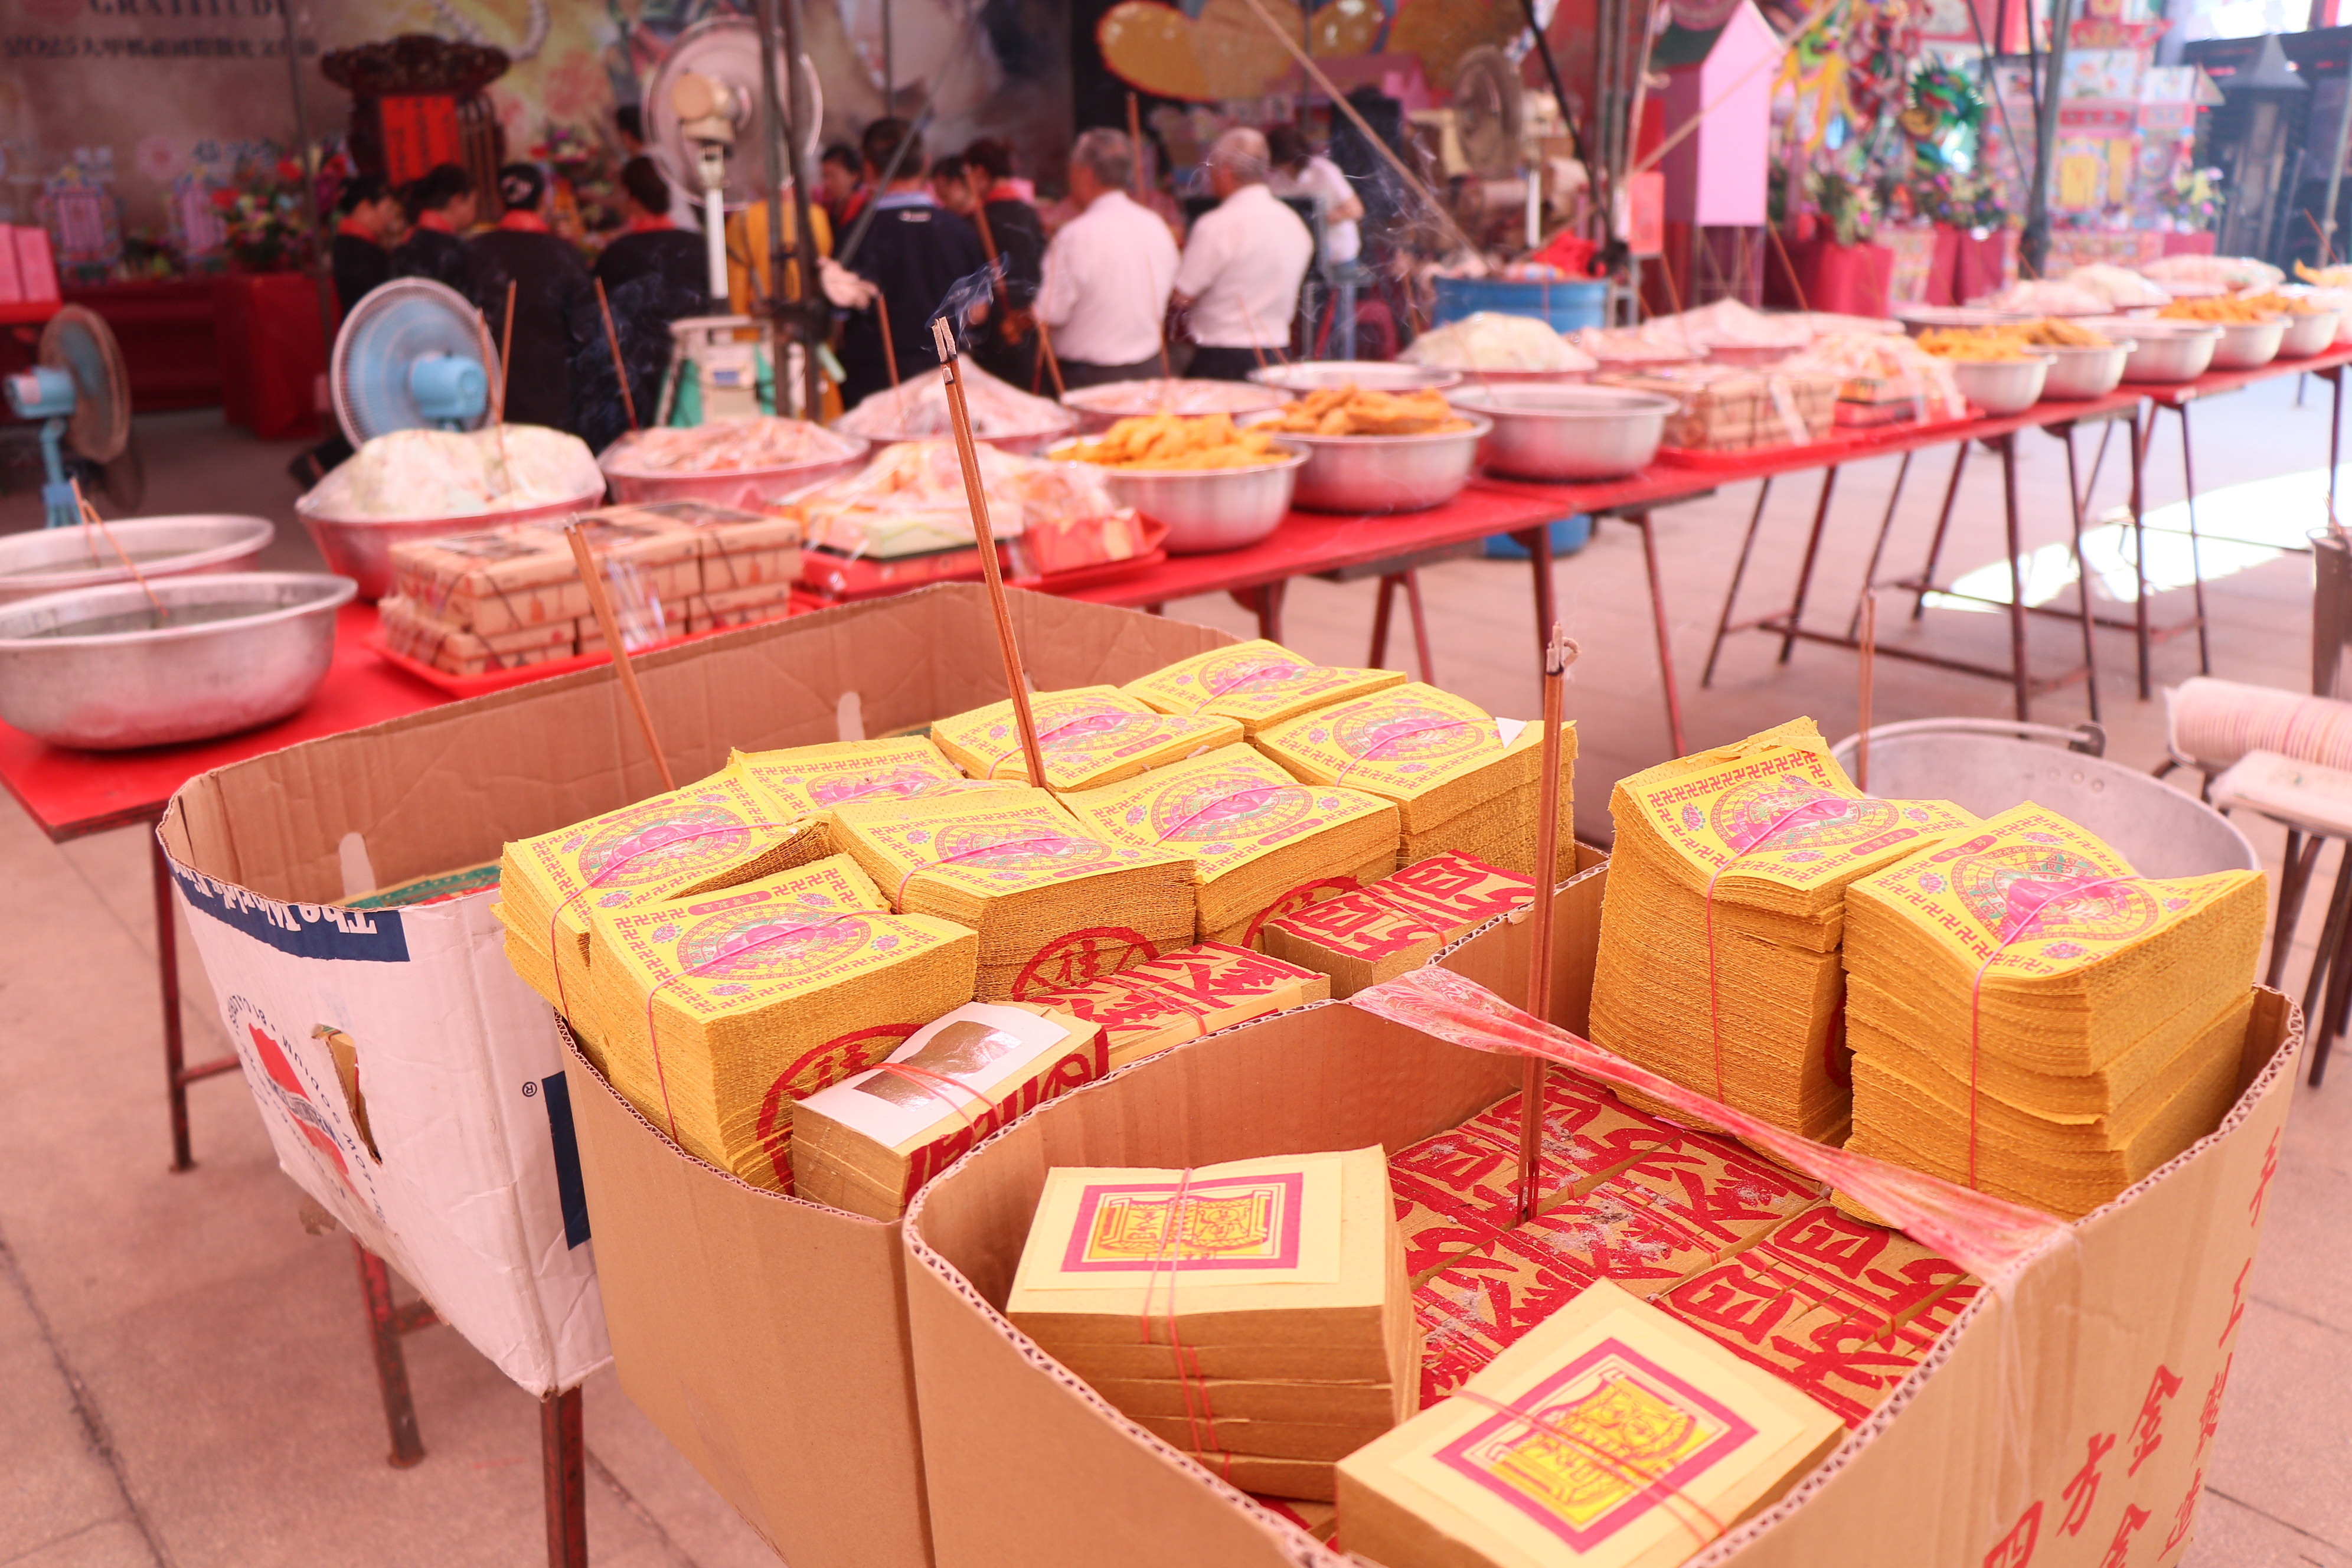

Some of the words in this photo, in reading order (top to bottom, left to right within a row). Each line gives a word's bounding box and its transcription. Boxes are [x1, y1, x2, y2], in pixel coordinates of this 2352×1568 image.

[699, 894, 759, 912] 台灣製造
[298, 906, 378, 934] The
[282, 1034, 342, 1124] SODIUM
